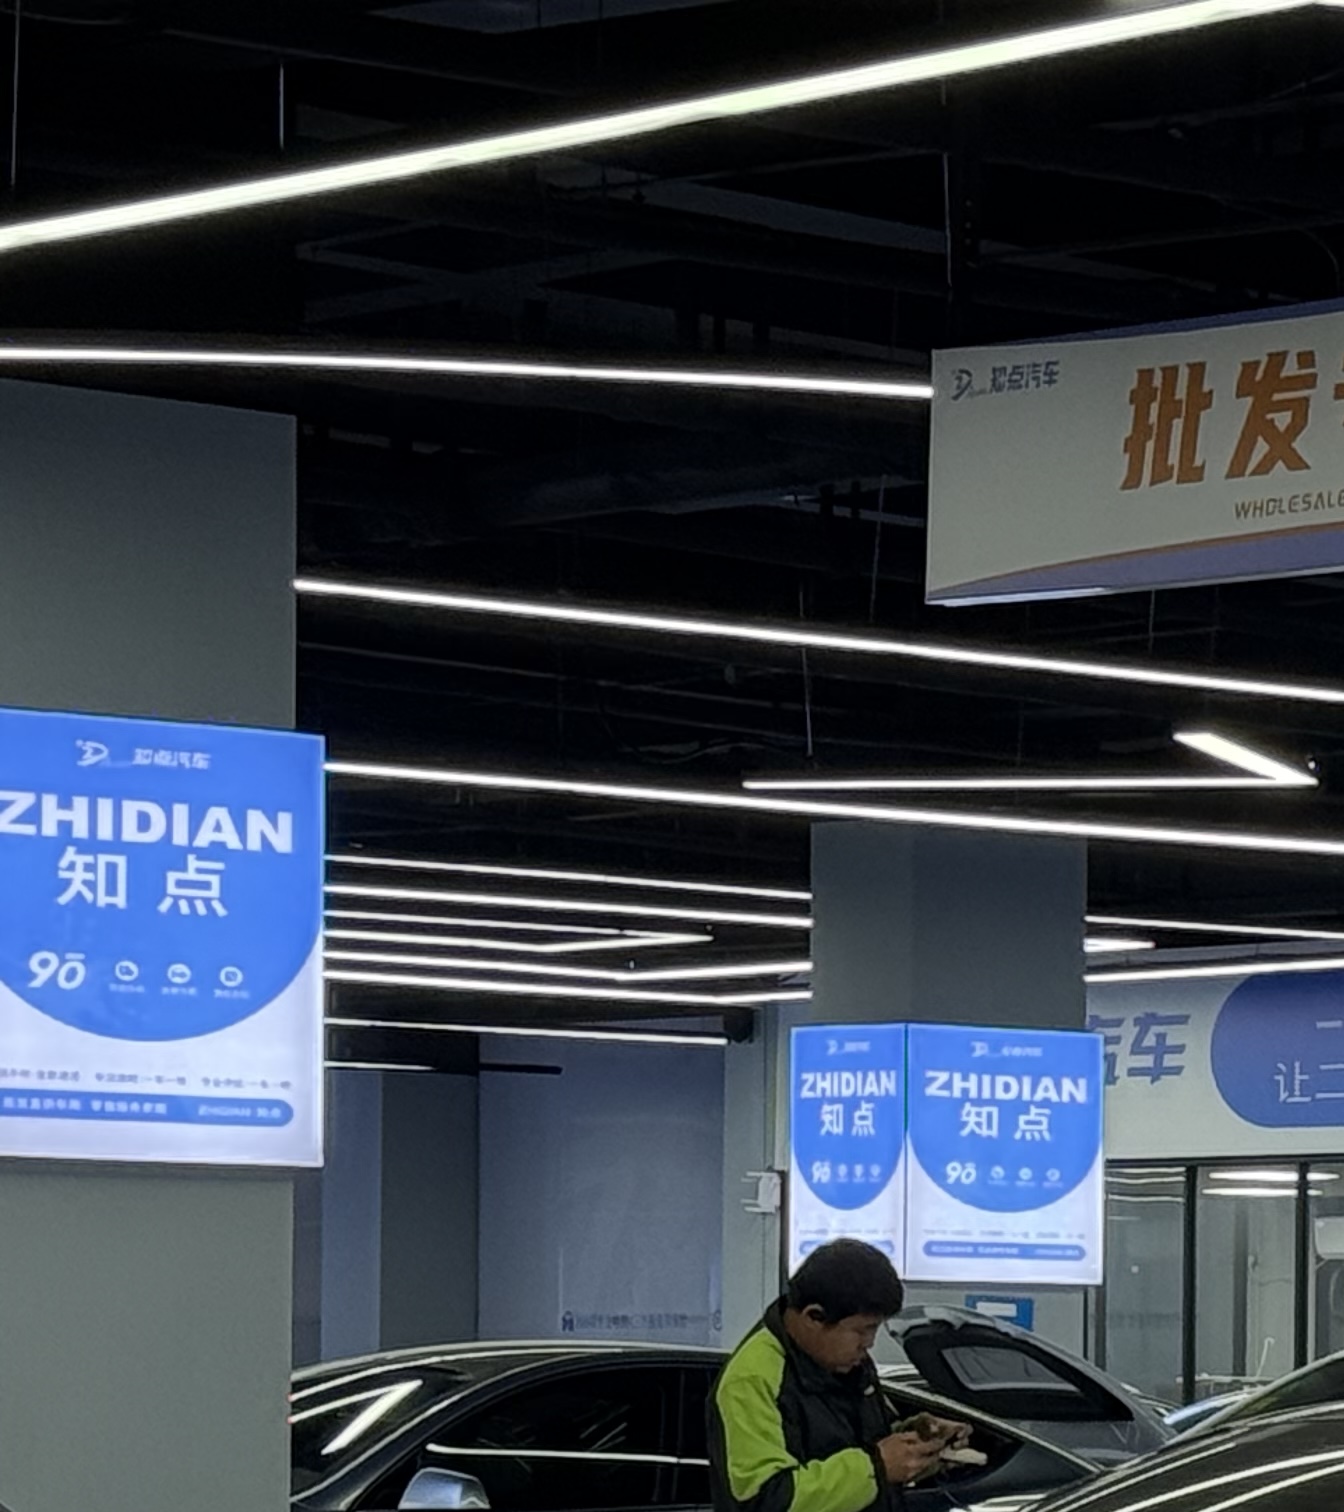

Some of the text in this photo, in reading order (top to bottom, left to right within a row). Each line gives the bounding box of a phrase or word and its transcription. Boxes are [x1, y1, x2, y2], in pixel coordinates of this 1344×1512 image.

[0, 791, 293, 854] ZHIDIAN
[57, 845, 229, 917] 知点
[800, 1070, 896, 1099] ZHIDIAN
[924, 1070, 1088, 1104] ZHIDIAN
[819, 1101, 876, 1137] 知点
[959, 1102, 1052, 1141] 知点
